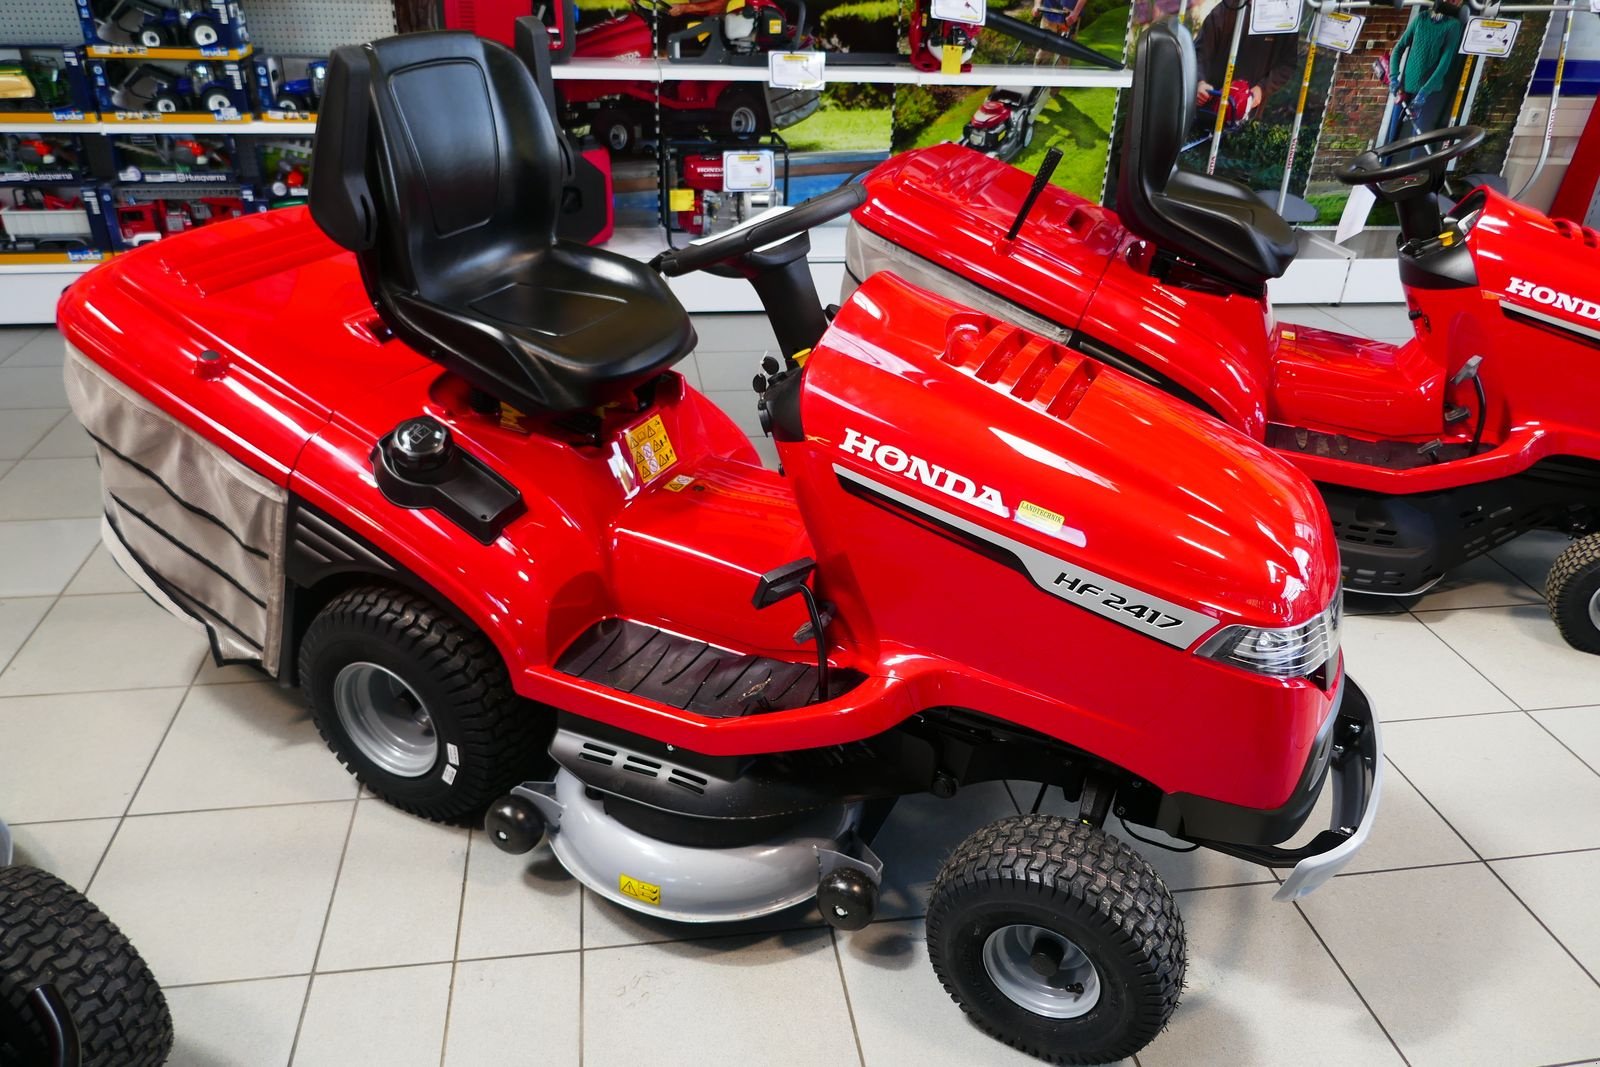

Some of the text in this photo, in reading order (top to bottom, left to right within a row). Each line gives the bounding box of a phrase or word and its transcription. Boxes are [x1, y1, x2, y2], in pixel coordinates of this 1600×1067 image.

[1287, 138, 1297, 169] HONDA
[30, 172, 73, 181] Husqvarna
[185, 173, 227, 182] Husqvarna
[1505, 276, 1600, 321] HOND
[838, 427, 1010, 518] HONDA
[1020, 502, 1063, 524] LANDTECHNIK
[1053, 572, 1185, 630] HF 2417
